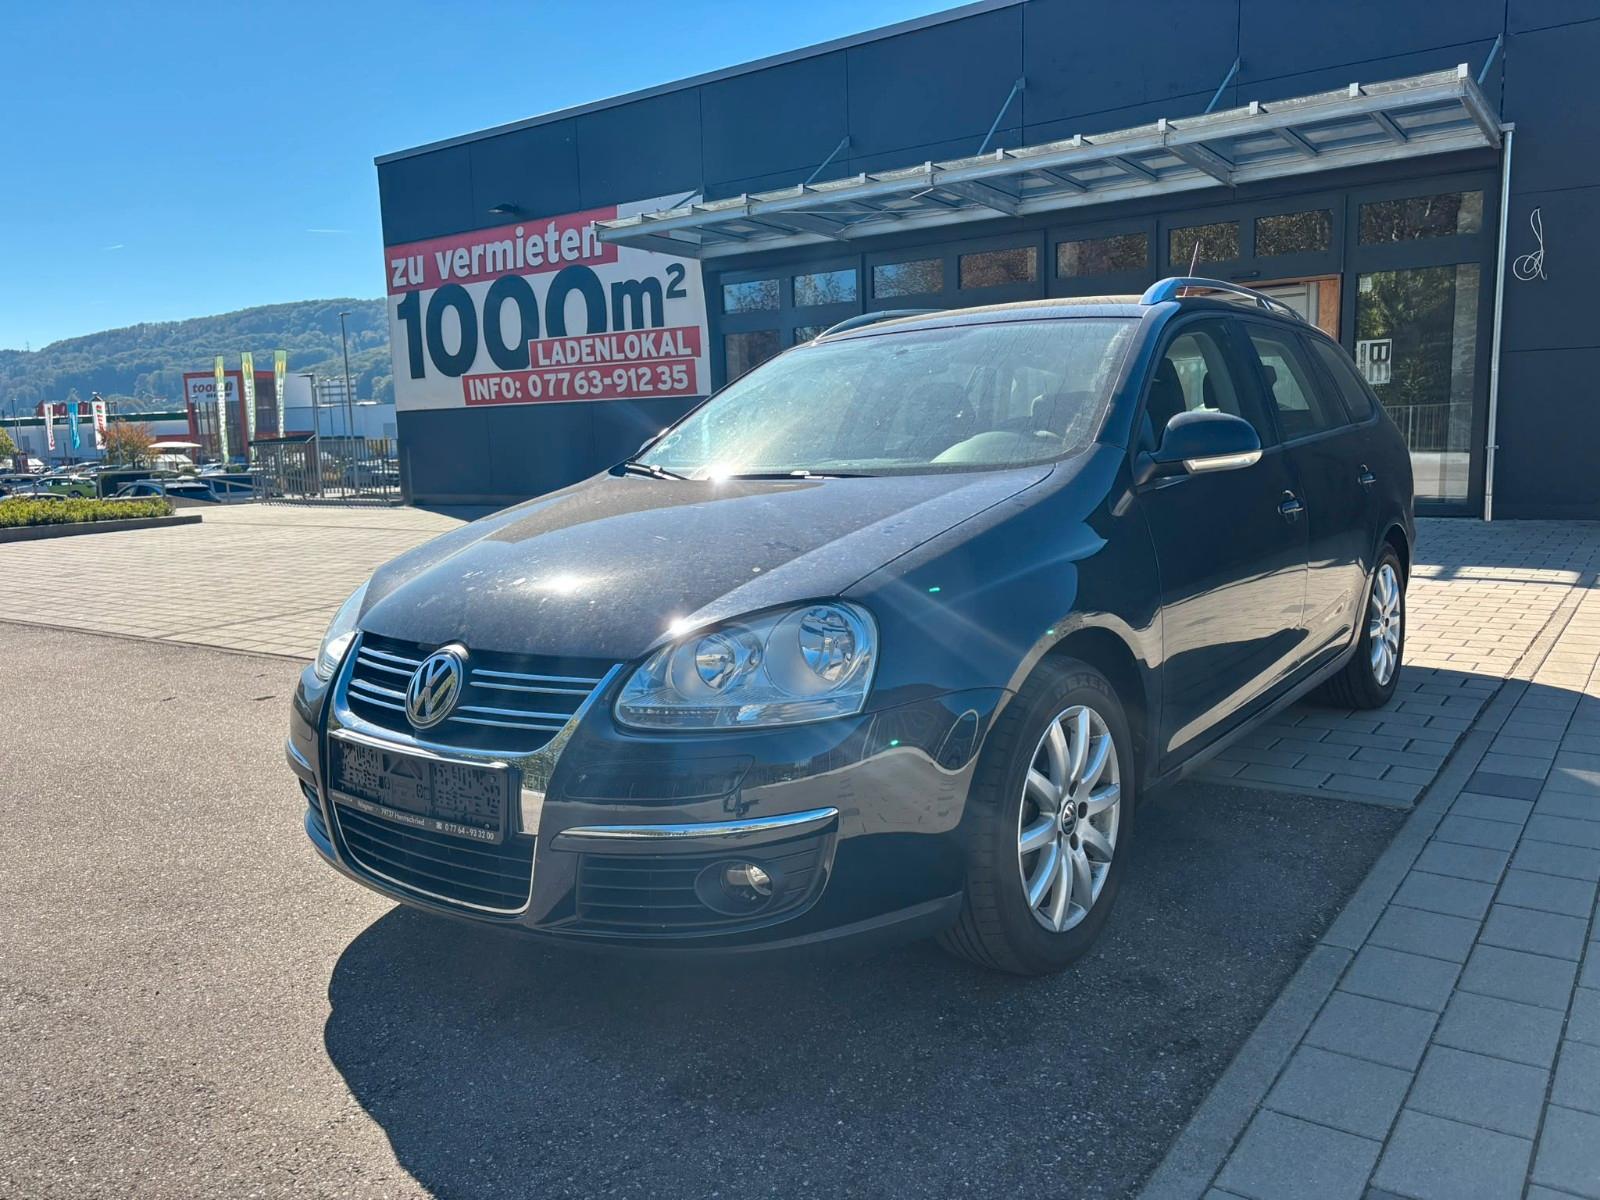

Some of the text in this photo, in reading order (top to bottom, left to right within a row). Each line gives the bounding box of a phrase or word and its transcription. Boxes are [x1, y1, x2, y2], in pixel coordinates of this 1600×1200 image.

[391, 221, 603, 288] zu vermieten
[537, 330, 692, 366] LADENLOKAL
[468, 376, 522, 401] INFO:
